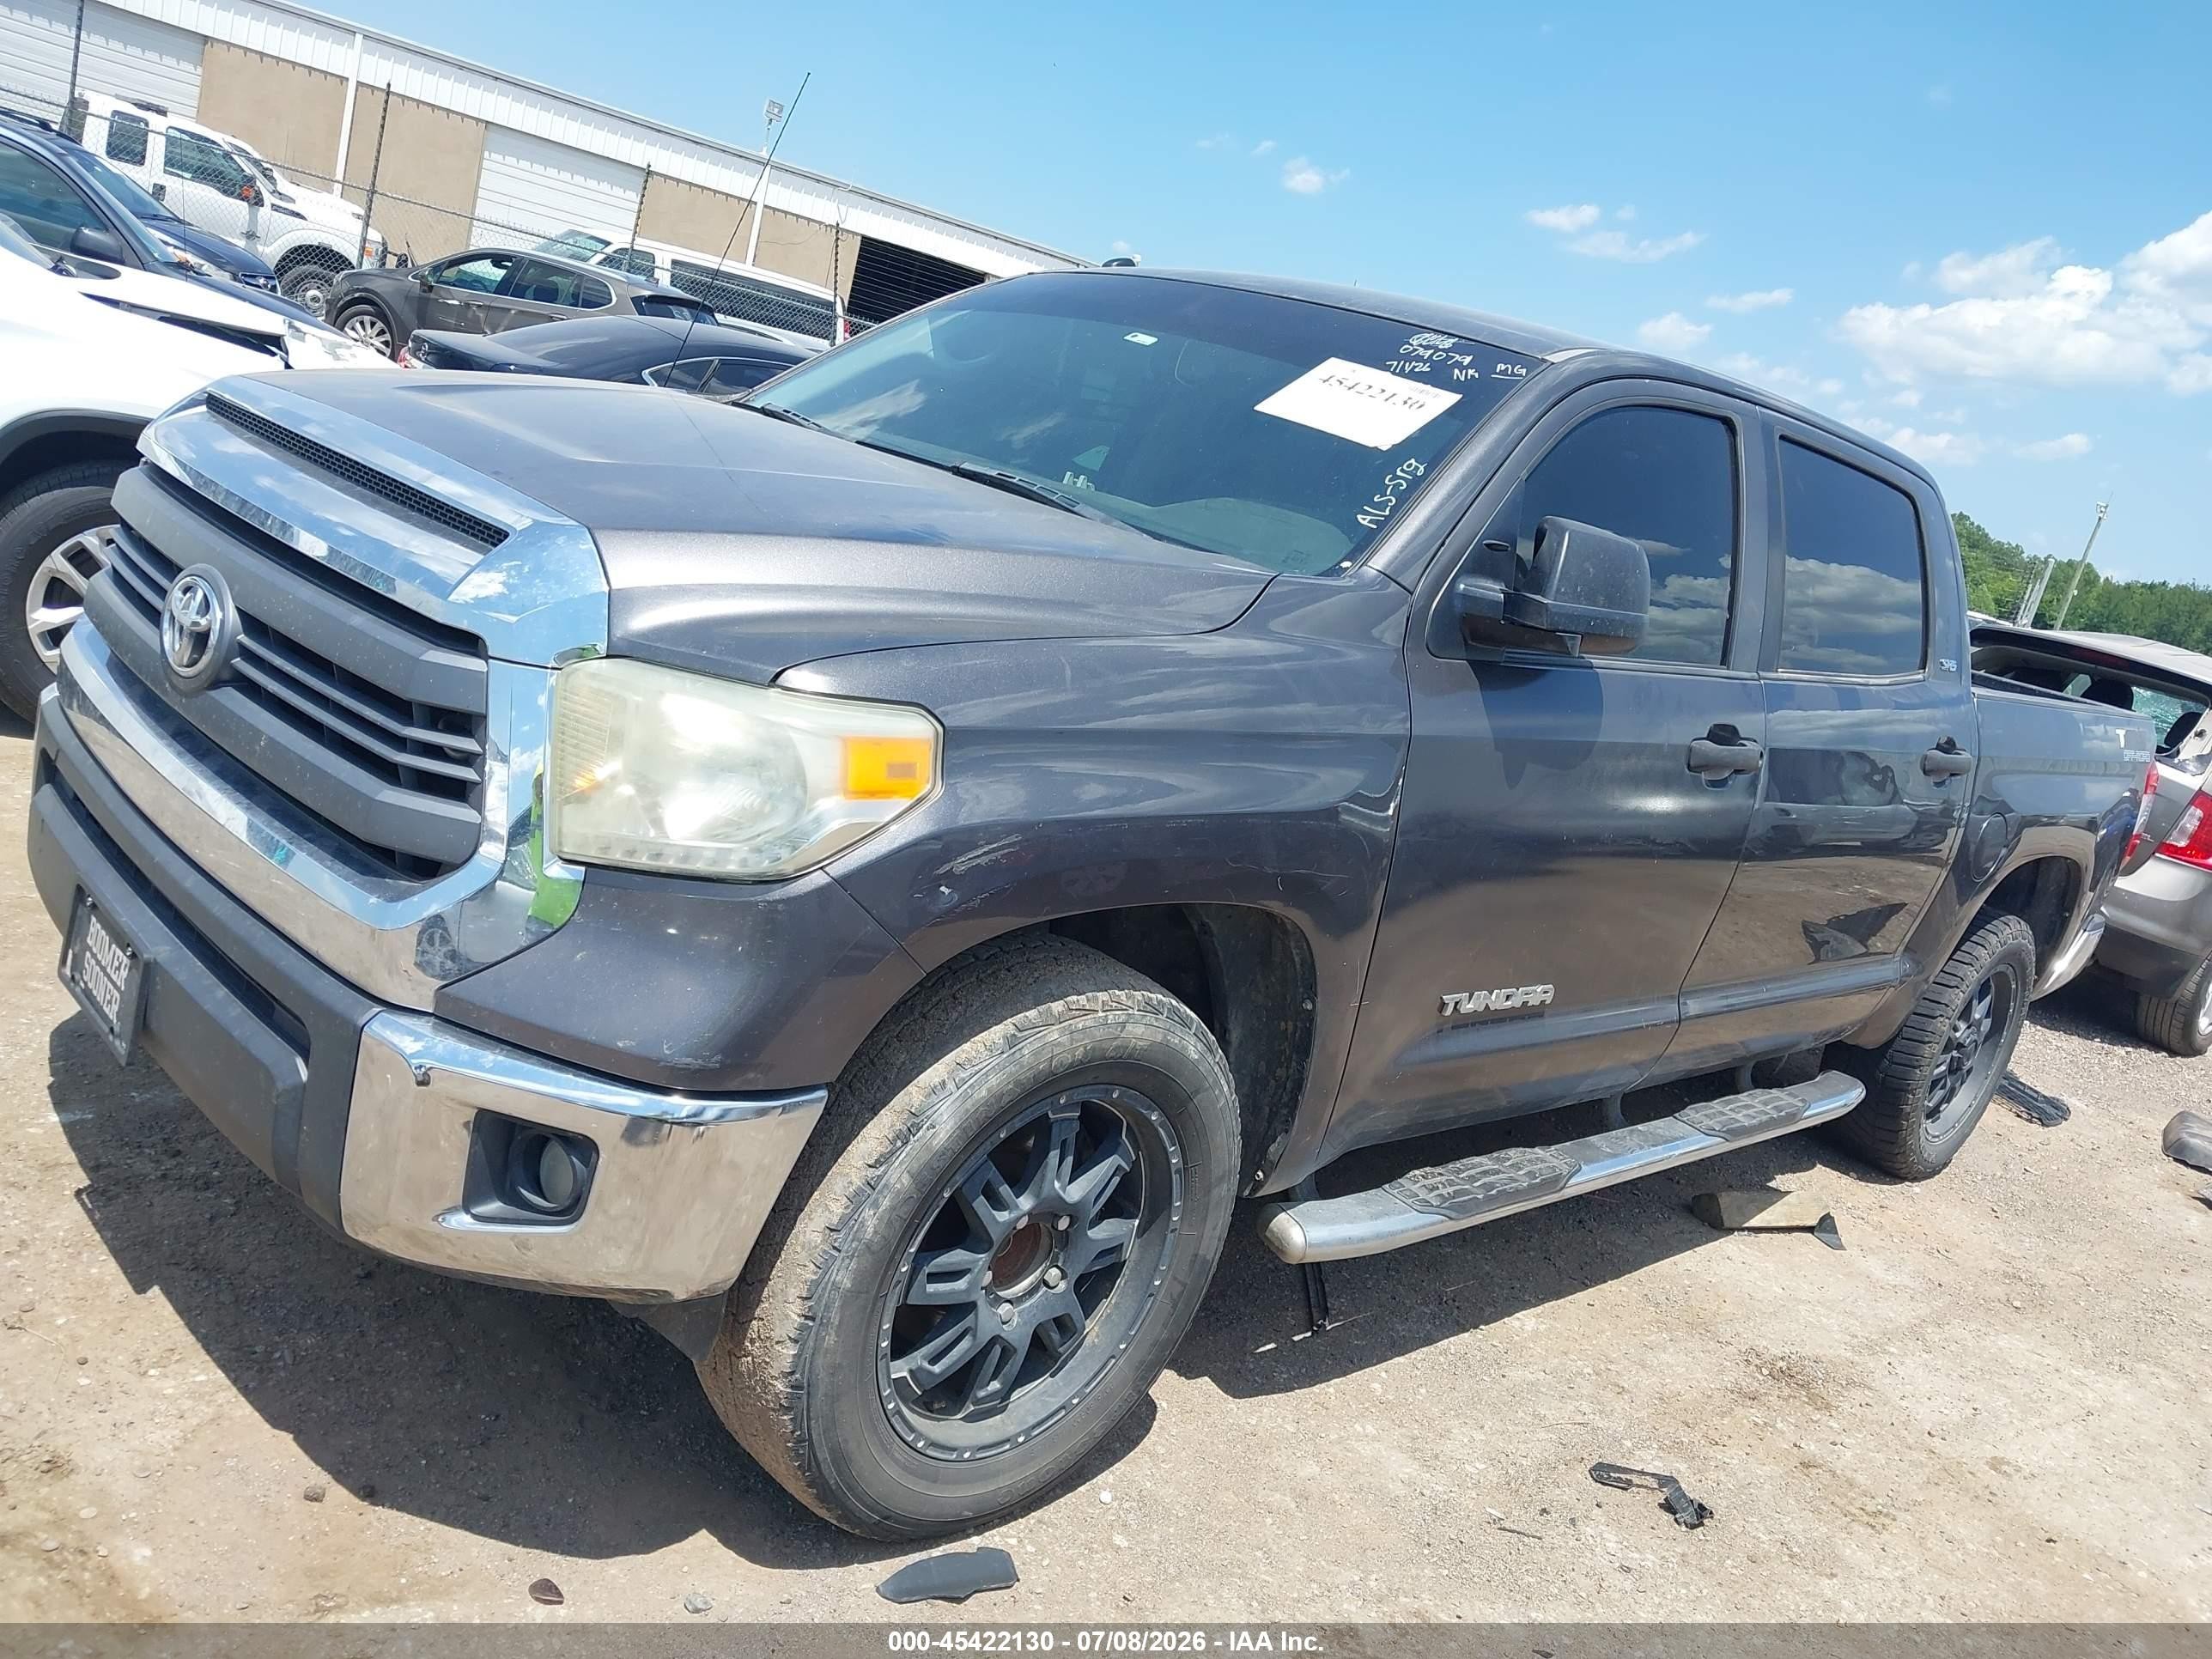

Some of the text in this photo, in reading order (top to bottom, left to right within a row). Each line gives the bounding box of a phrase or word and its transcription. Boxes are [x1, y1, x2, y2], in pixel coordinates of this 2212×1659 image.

[1496, 363, 1527, 376] MG
[87, 915, 130, 991] BOOMER
[82, 951, 121, 1024] SOONER
[1439, 984, 1555, 1017] TUNDRA
